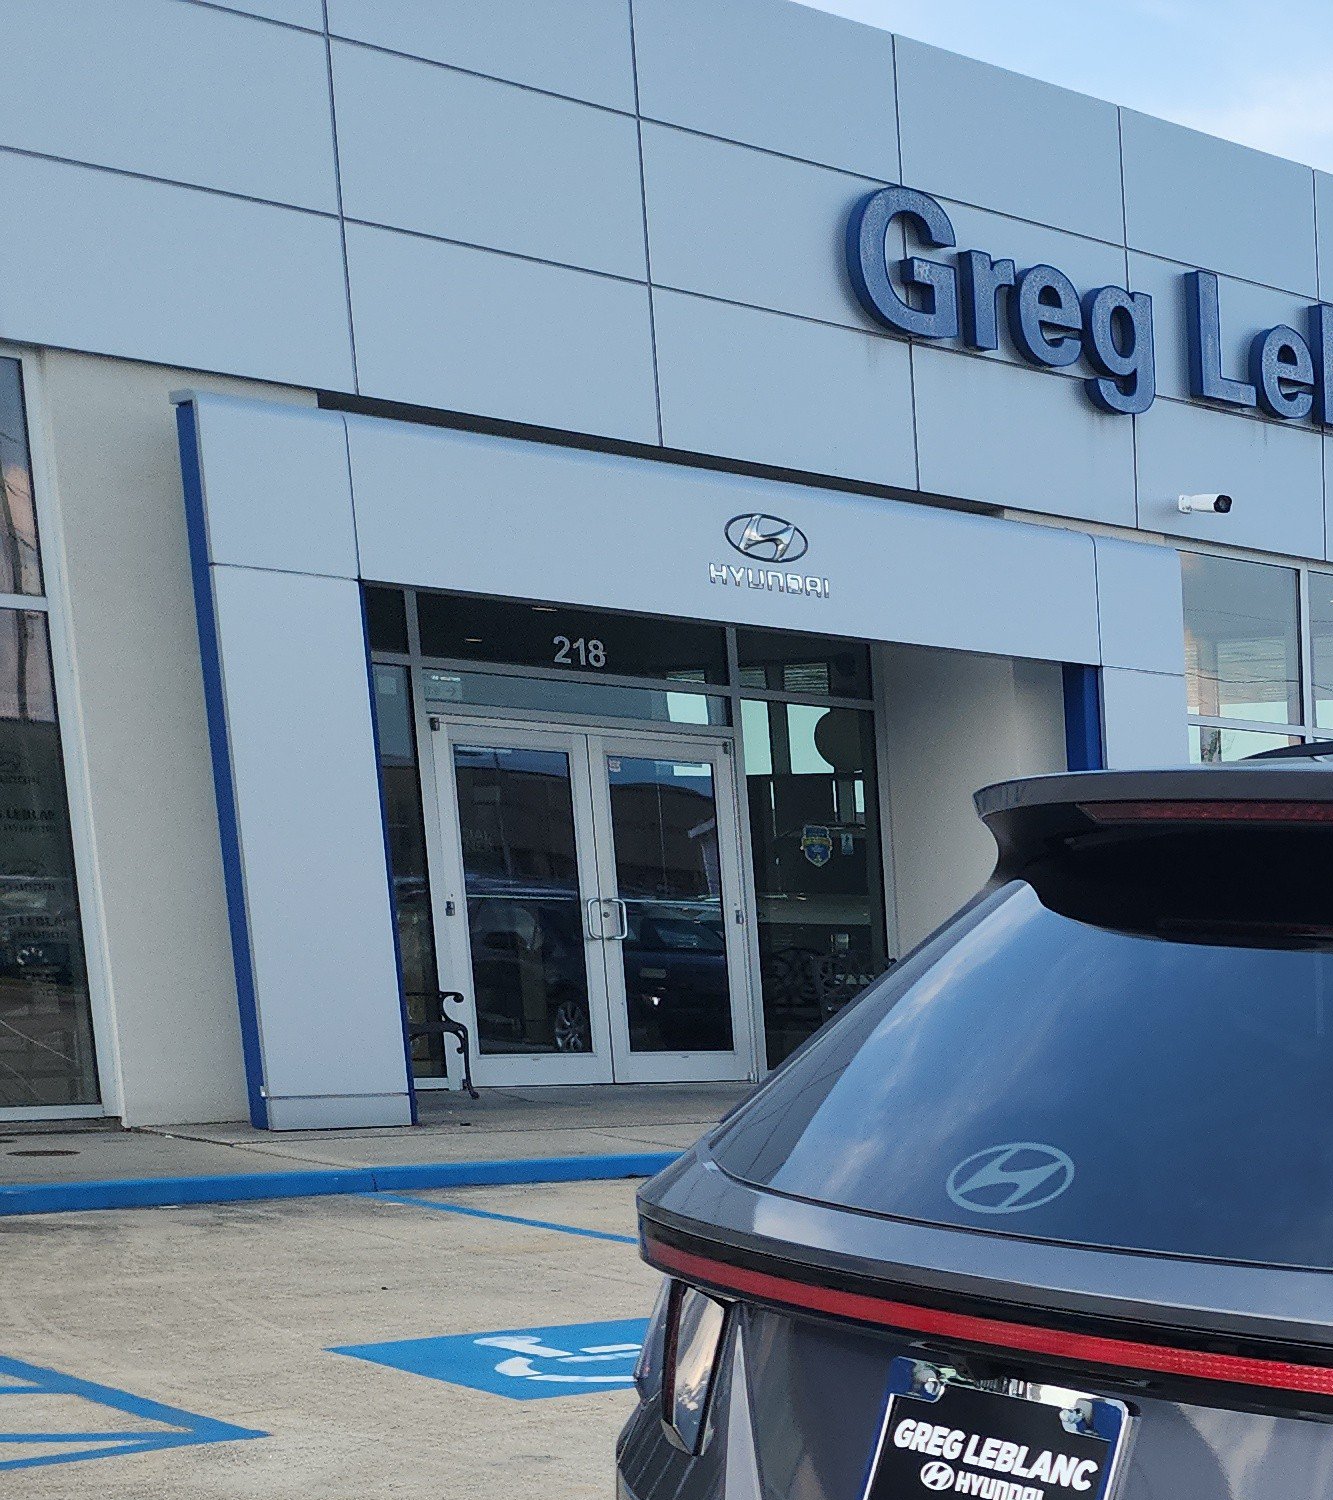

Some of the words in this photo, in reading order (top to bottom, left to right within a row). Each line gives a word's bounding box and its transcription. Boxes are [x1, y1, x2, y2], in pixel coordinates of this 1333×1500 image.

[845, 186, 1156, 415] Greg
[708, 563, 830, 598] HYUNDAI
[552, 635, 607, 668] 218
[893, 1418, 967, 1460] GREG
[962, 1434, 1099, 1492] LEBLANC
